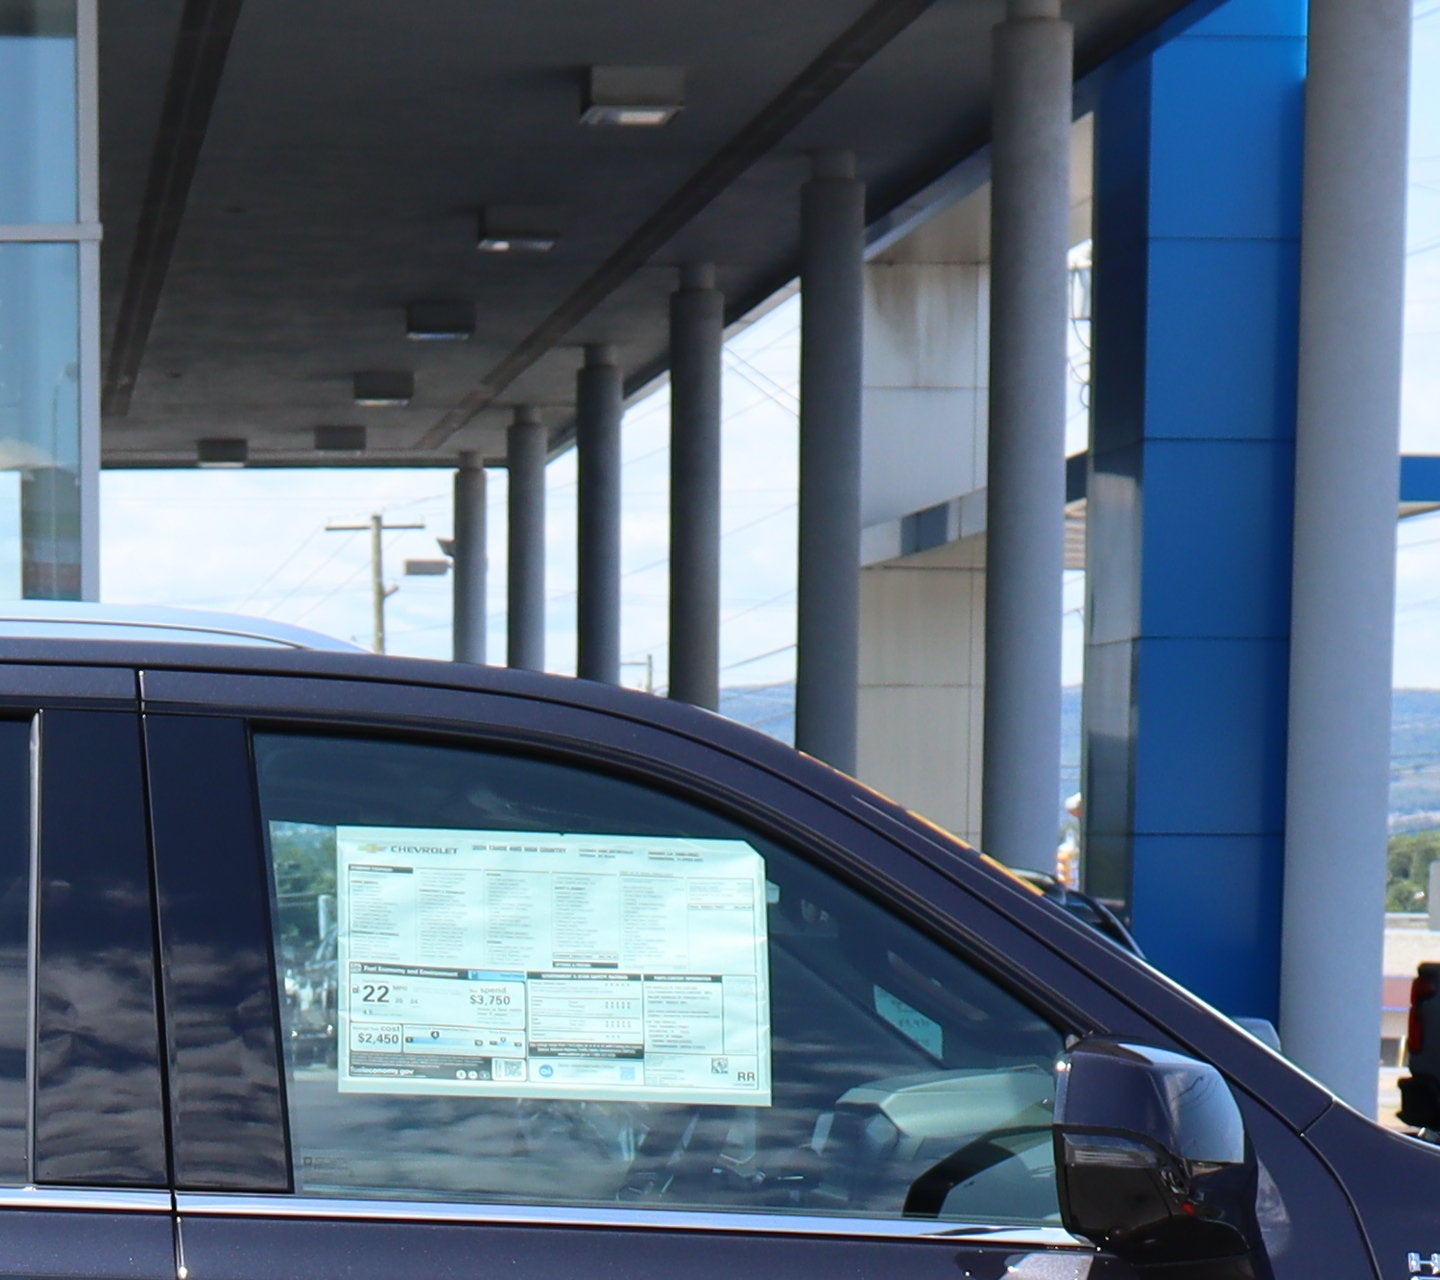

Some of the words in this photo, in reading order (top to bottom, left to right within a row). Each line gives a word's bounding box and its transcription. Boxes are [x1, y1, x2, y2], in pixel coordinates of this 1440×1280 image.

[390, 845, 459, 855] CHEVROLET
[362, 984, 390, 1003] 22
[480, 986, 507, 995] spend
[470, 994, 511, 1007] $3,750
[381, 1025, 401, 1033] cost
[358, 1032, 400, 1045] $2,450
[737, 1071, 756, 1082] RR
